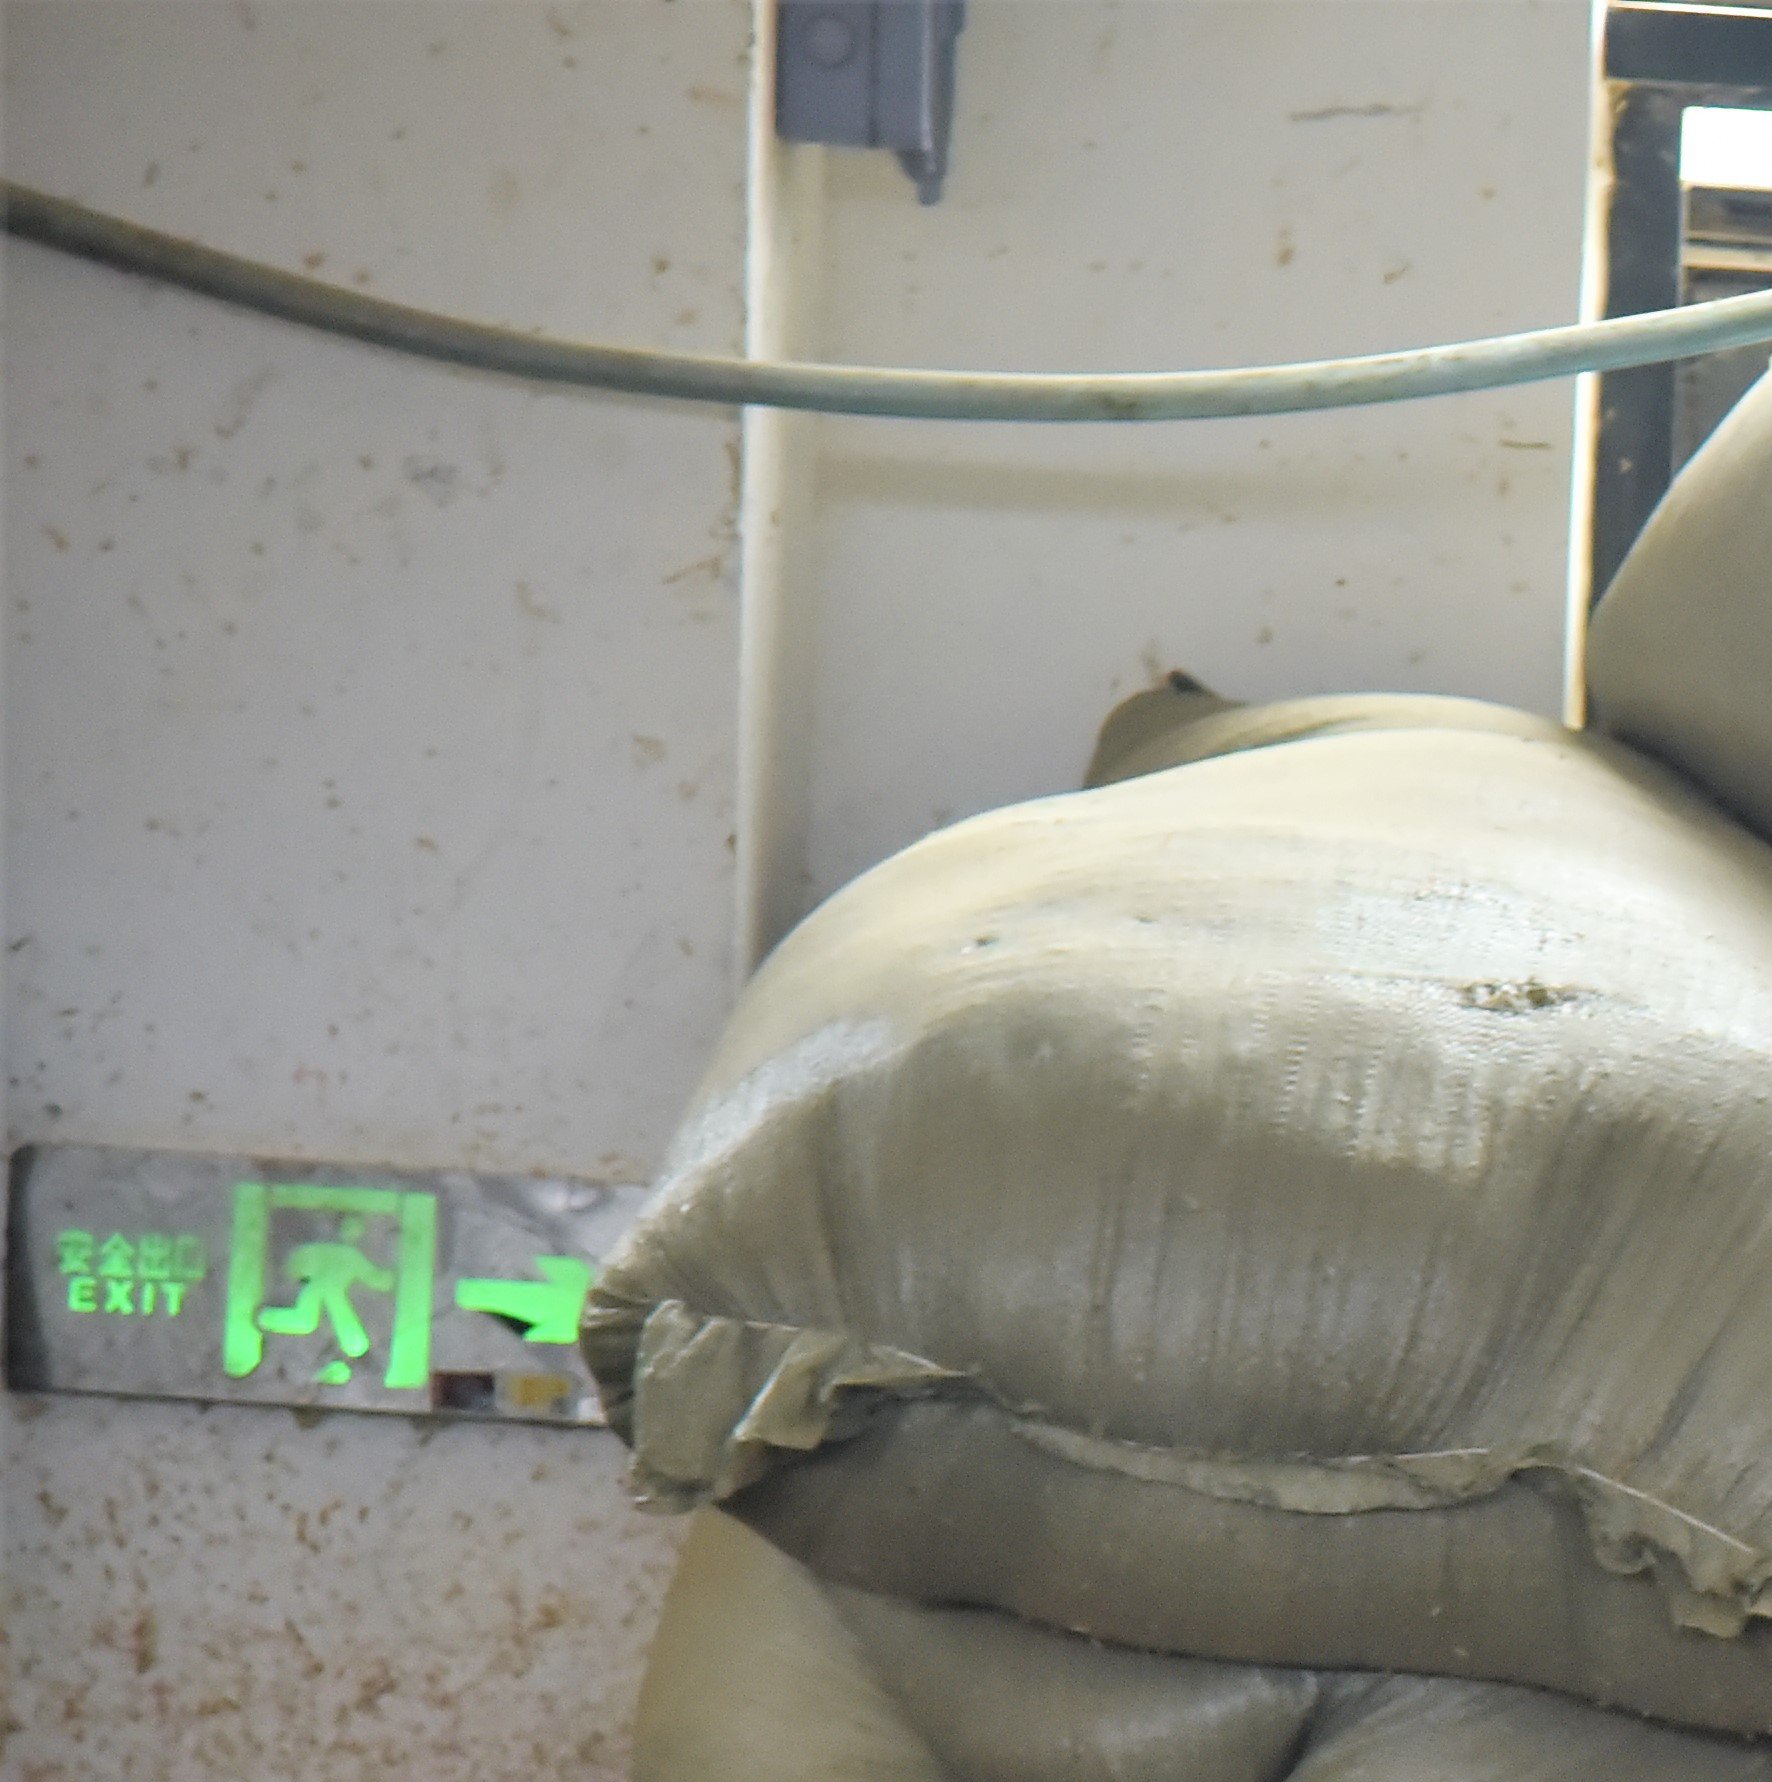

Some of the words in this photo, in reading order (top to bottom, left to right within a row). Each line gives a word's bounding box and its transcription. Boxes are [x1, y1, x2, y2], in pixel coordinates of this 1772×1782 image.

[57, 1229, 206, 1278] 安全出口
[69, 1279, 187, 1316] EXIT
